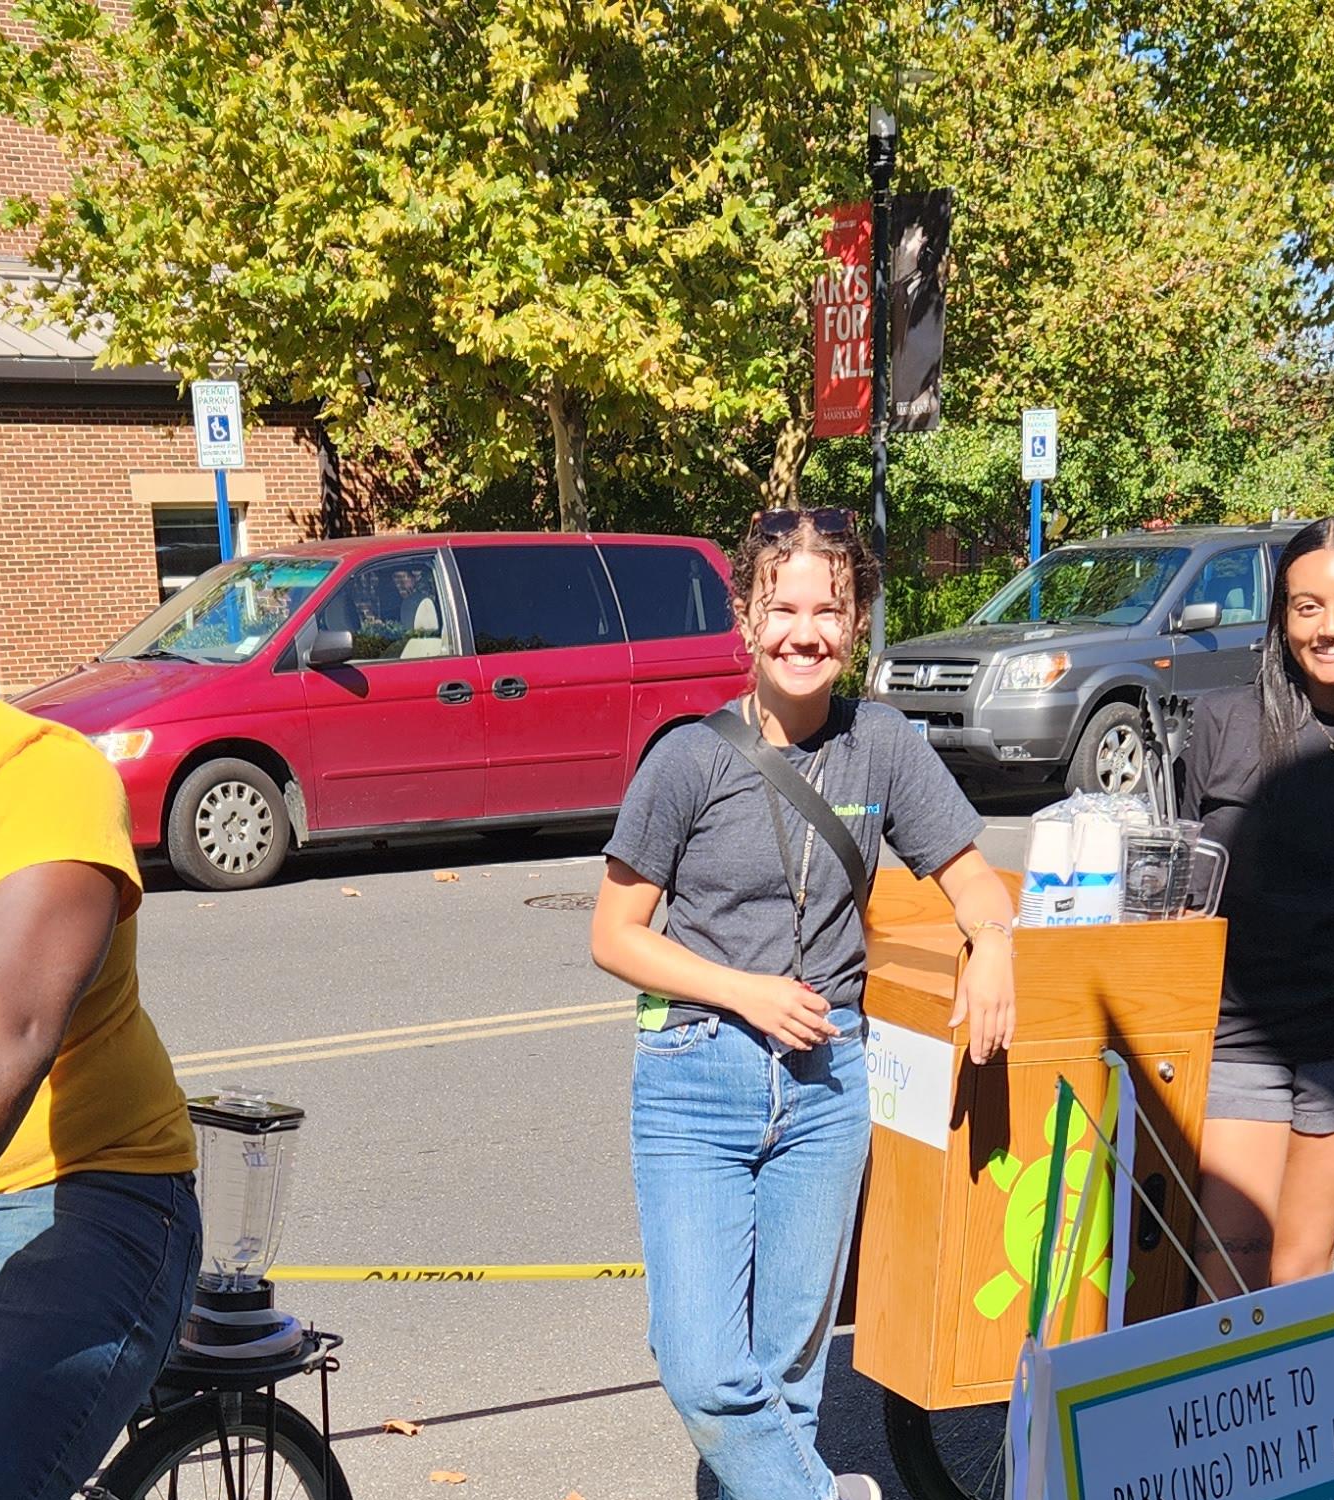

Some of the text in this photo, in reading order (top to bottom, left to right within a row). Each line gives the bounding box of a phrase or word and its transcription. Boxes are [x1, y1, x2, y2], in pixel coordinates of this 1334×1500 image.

[814, 265, 869, 305] ARTS
[824, 304, 870, 343] FOR
[830, 342, 872, 380] ALL
[198, 396, 234, 405] PARKING
[200, 387, 230, 396] PERMIT
[206, 405, 228, 414] ONLY
[867, 1049, 912, 1091] bility
[1168, 1363, 1317, 1449] WELCOME TO
[1245, 1434, 1285, 1489] DAY
[1294, 1423, 1321, 1472] AT
